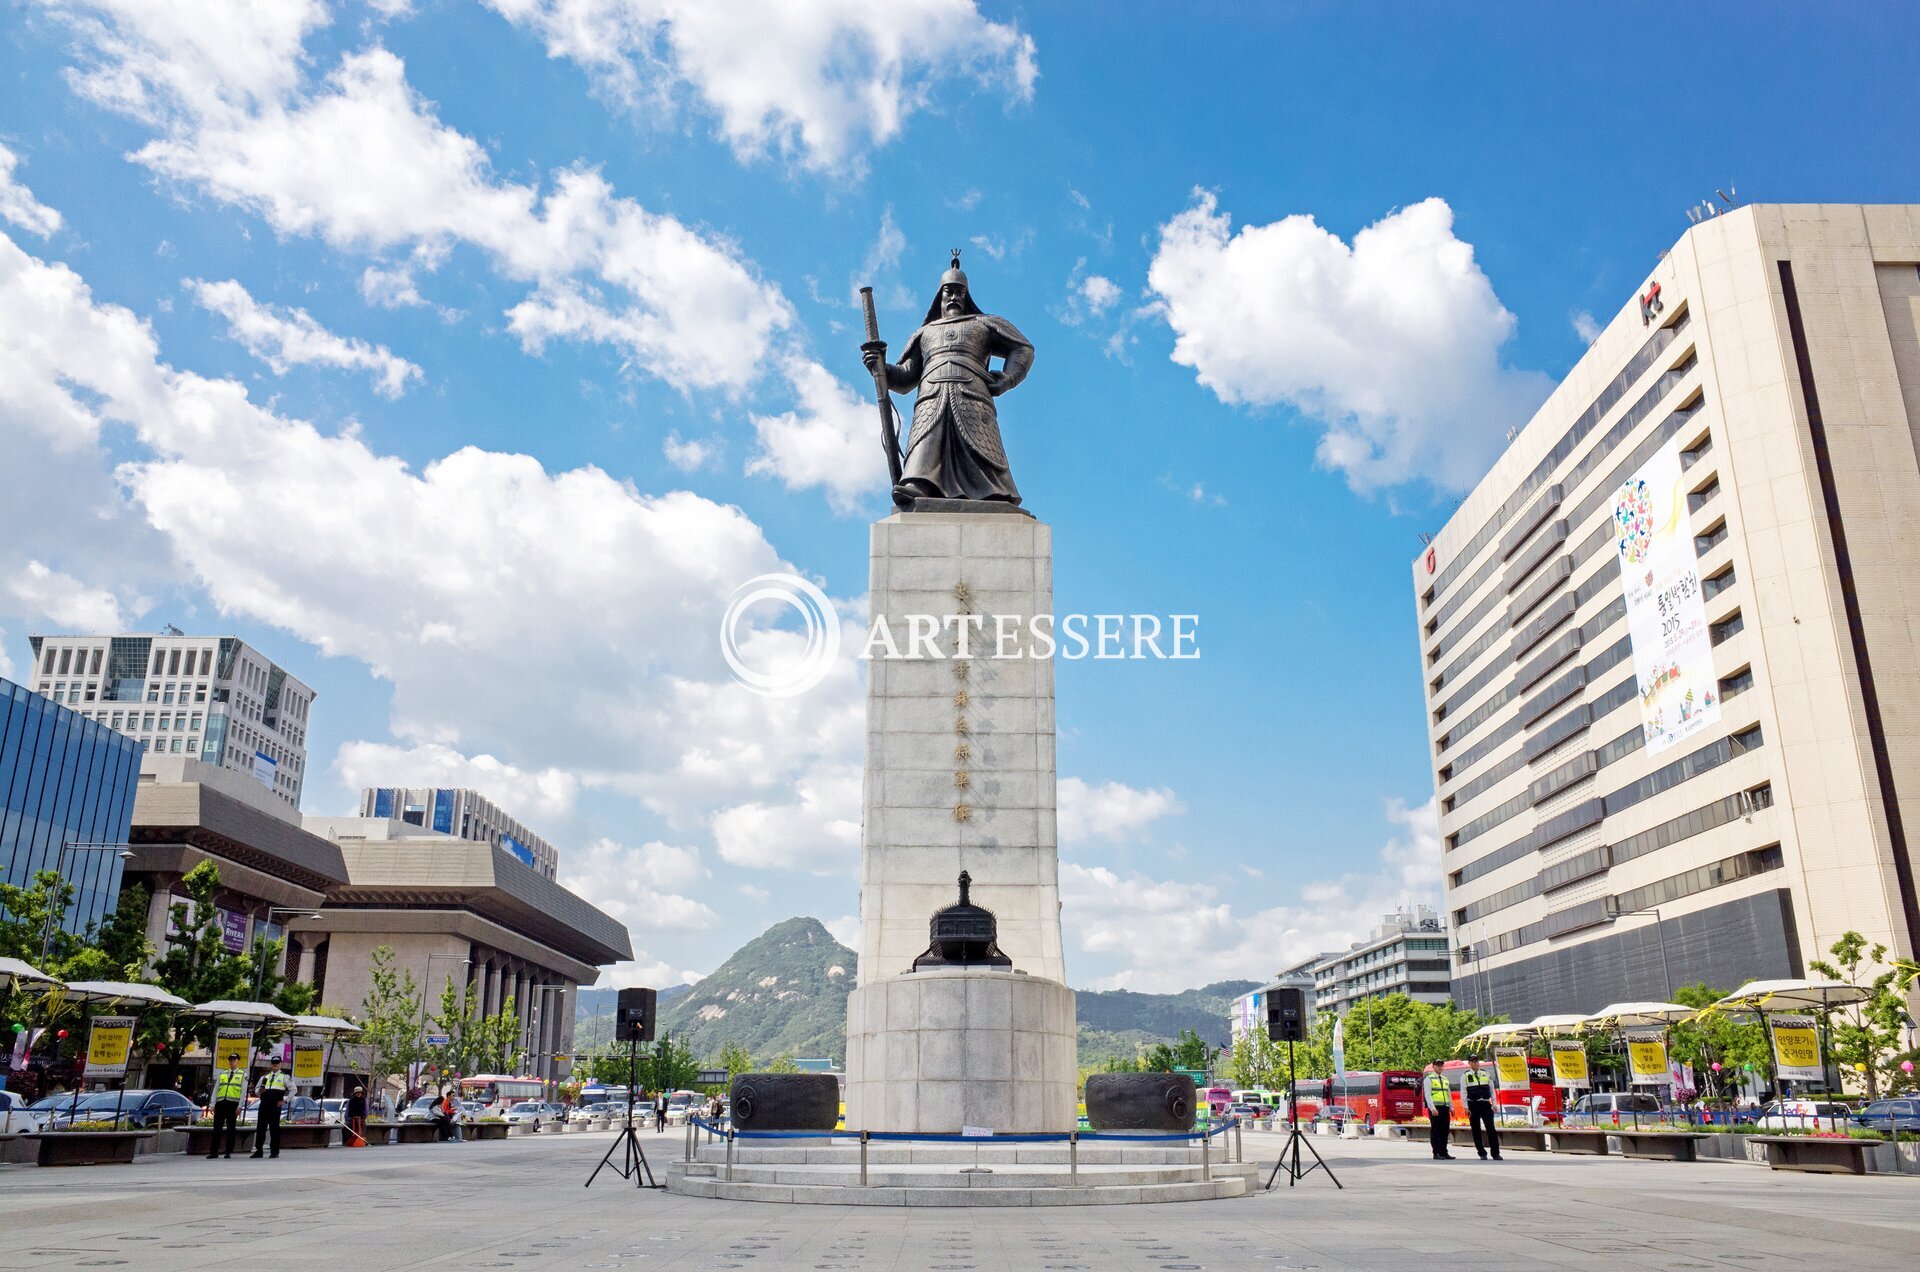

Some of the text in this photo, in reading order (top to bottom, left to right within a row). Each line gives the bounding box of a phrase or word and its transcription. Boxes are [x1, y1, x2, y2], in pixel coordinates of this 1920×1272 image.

[1658, 570, 1697, 617] 통일박람회
[1661, 612, 1680, 637] 2015
[952, 578, 971, 823] 忠李舜臣將軍像
[226, 928, 244, 939] RIVERA
[1783, 1048, 1814, 1059] 증거인멸
